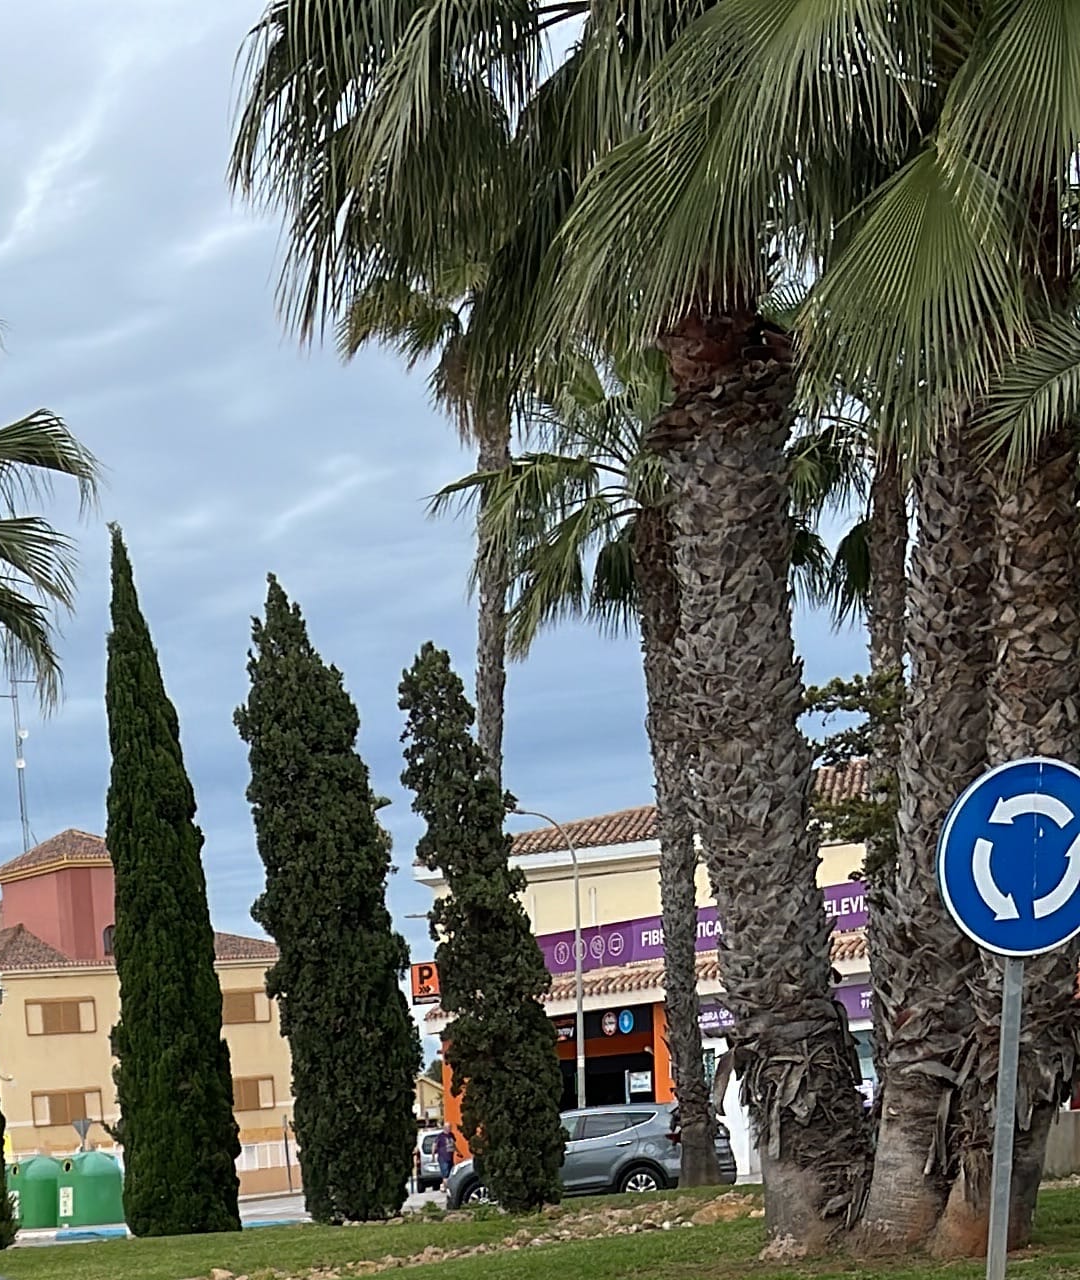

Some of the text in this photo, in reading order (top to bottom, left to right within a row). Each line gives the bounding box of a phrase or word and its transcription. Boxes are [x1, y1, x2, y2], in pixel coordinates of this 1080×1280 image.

[641, 928, 665, 947] FIB
[696, 920, 724, 938] TICA
[418, 965, 433, 985] P
